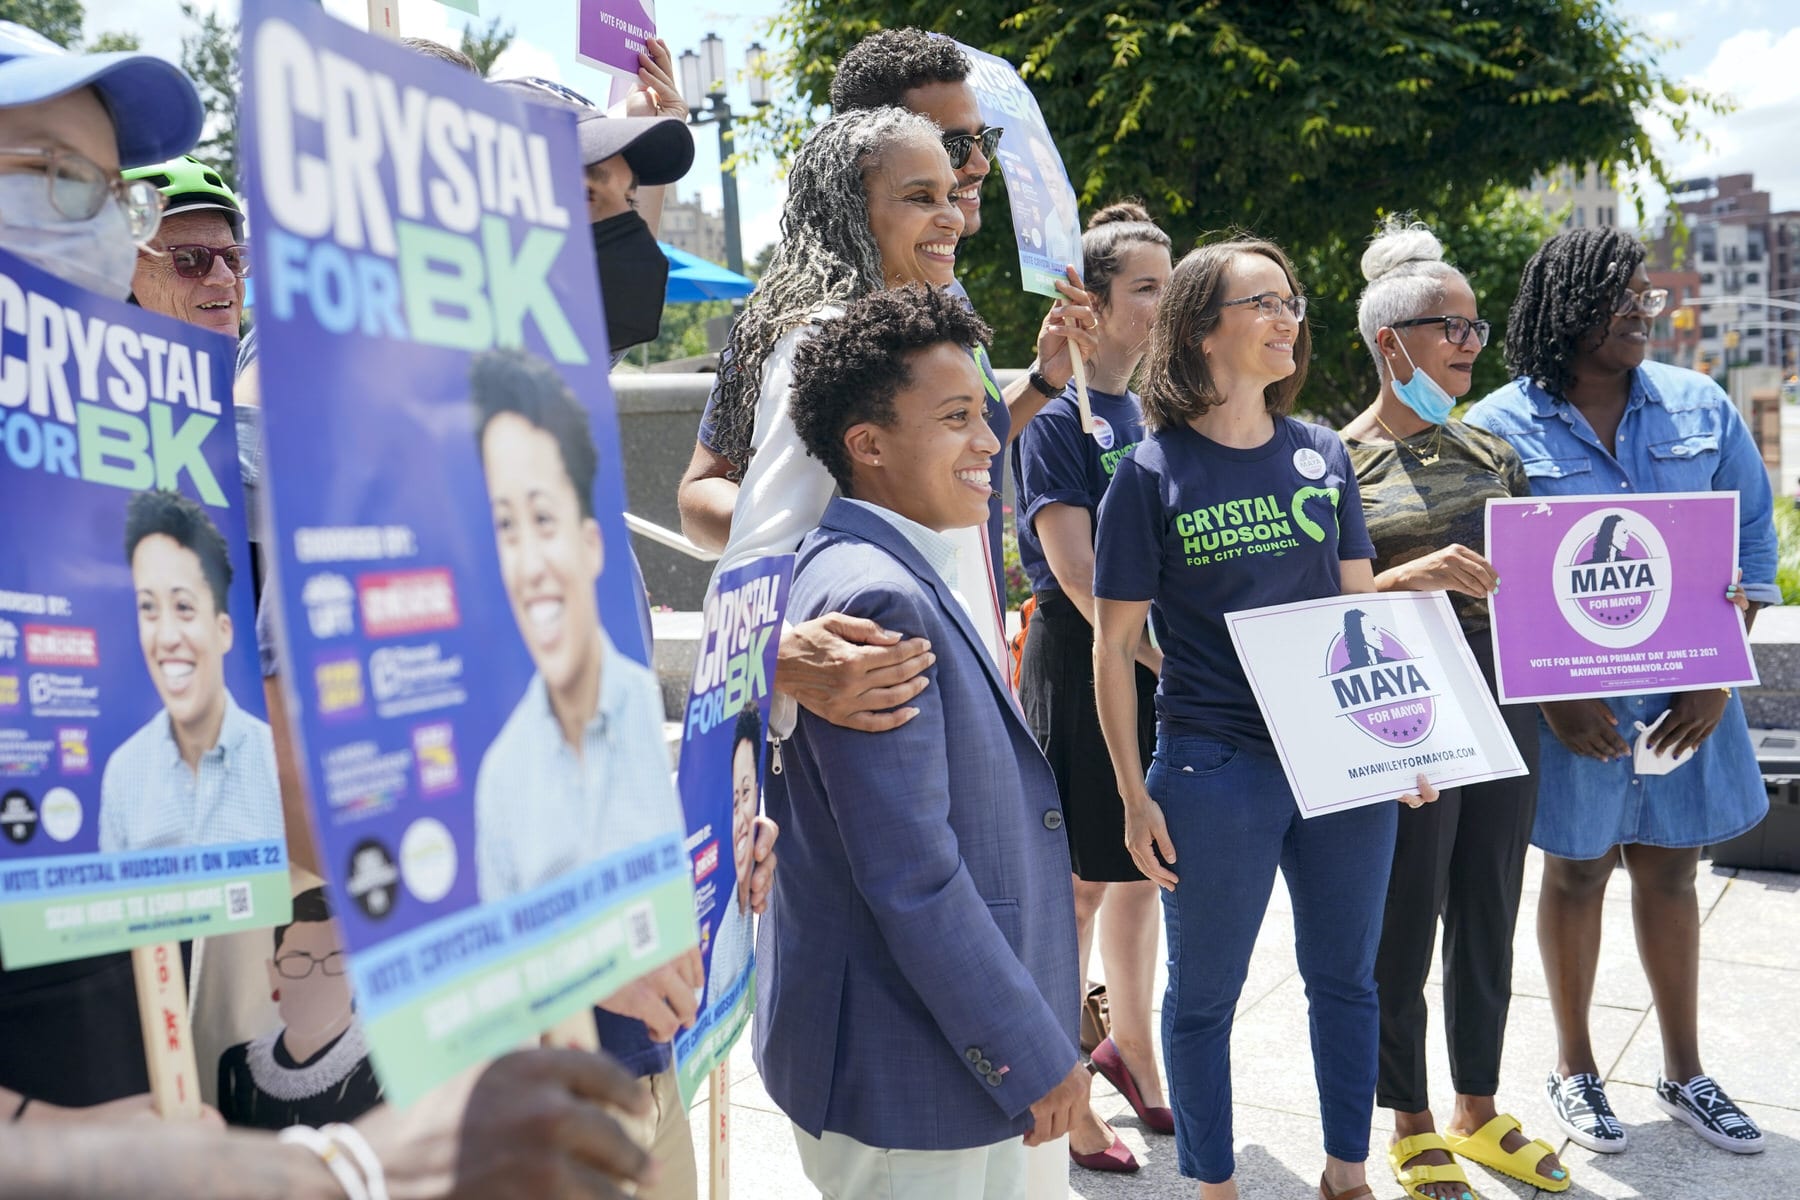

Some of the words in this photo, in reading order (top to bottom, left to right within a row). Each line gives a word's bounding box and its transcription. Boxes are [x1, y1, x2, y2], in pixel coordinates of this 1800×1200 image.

[600, 10, 615, 27] VOTE
[615, 17, 627, 32] FOR
[627, 23, 643, 39] MAYA
[254, 17, 570, 258] CRYSTAL
[265, 228, 408, 340] FOR
[396, 214, 590, 366] BK
[0, 407, 80, 479] OR
[77, 401, 230, 508] BK
[1176, 495, 1287, 537] CRYSTAL
[1183, 521, 1292, 554] HUDSON
[1186, 556, 1210, 566] FOR
[1214, 548, 1242, 562] CITY
[1247, 539, 1299, 554] COUNCIL
[1571, 563, 1655, 594] MAYA
[1589, 597, 1609, 610] FOR
[1609, 595, 1642, 608] MAYOR
[693, 574, 780, 696] CRYSTAL
[1530, 658, 1552, 668] VOTE
[1554, 656, 1571, 666] FOR
[1571, 655, 1595, 665] MAYA
[1596, 654, 1609, 664] ON
[1610, 652, 1646, 663] PRIMARY
[1648, 651, 1664, 661] DAY
[1666, 649, 1688, 660] JUNE
[1689, 649, 1699, 658] 22
[1700, 648, 1718, 657] 2021
[1570, 661, 1684, 677] MAYAWILEYFORMAYOR.COM
[686, 688, 726, 742] FOR
[723, 625, 774, 721] BK
[1331, 664, 1430, 709] MAYA
[1367, 710, 1393, 726] FOR
[1391, 703, 1426, 722] MAYOR
[1348, 747, 1475, 779] MAYAWILEYFORMAYOR.COM
[263, 845, 280, 865] 22
